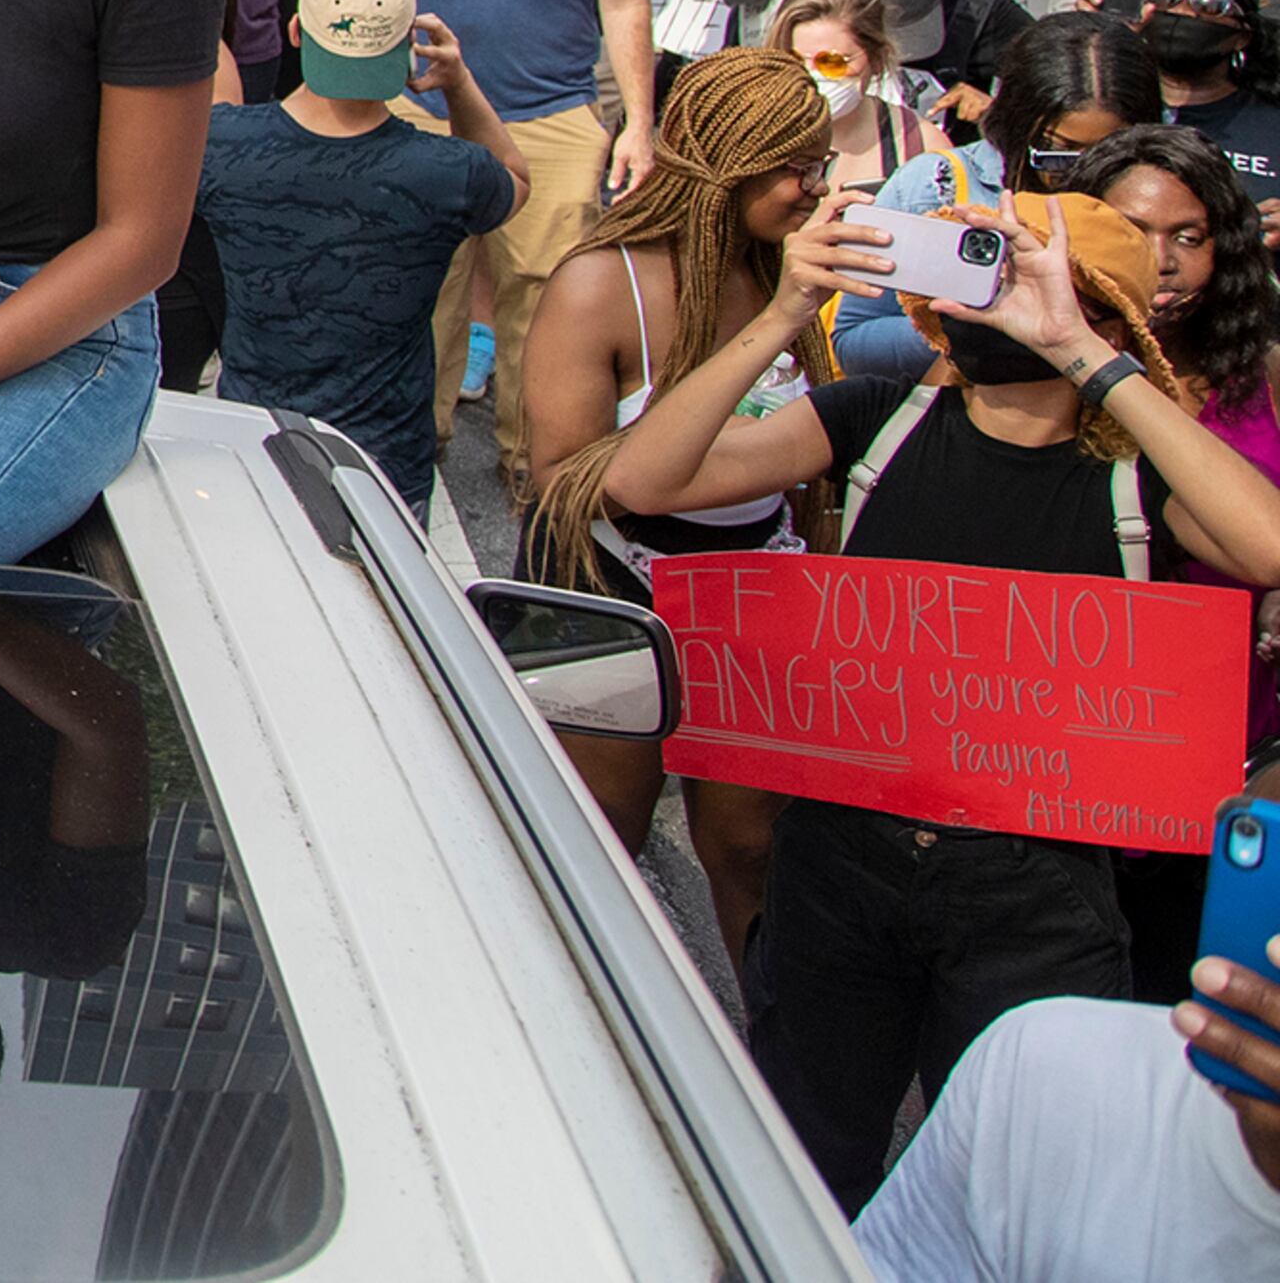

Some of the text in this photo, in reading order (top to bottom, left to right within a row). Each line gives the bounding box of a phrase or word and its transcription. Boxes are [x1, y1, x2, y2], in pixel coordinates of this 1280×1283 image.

[666, 568, 1205, 668] IF YOU'RE NOT
[681, 638, 1179, 748] ANGRY you're NOT
[951, 730, 1072, 788] Paying
[1026, 789, 1205, 846] Attention
